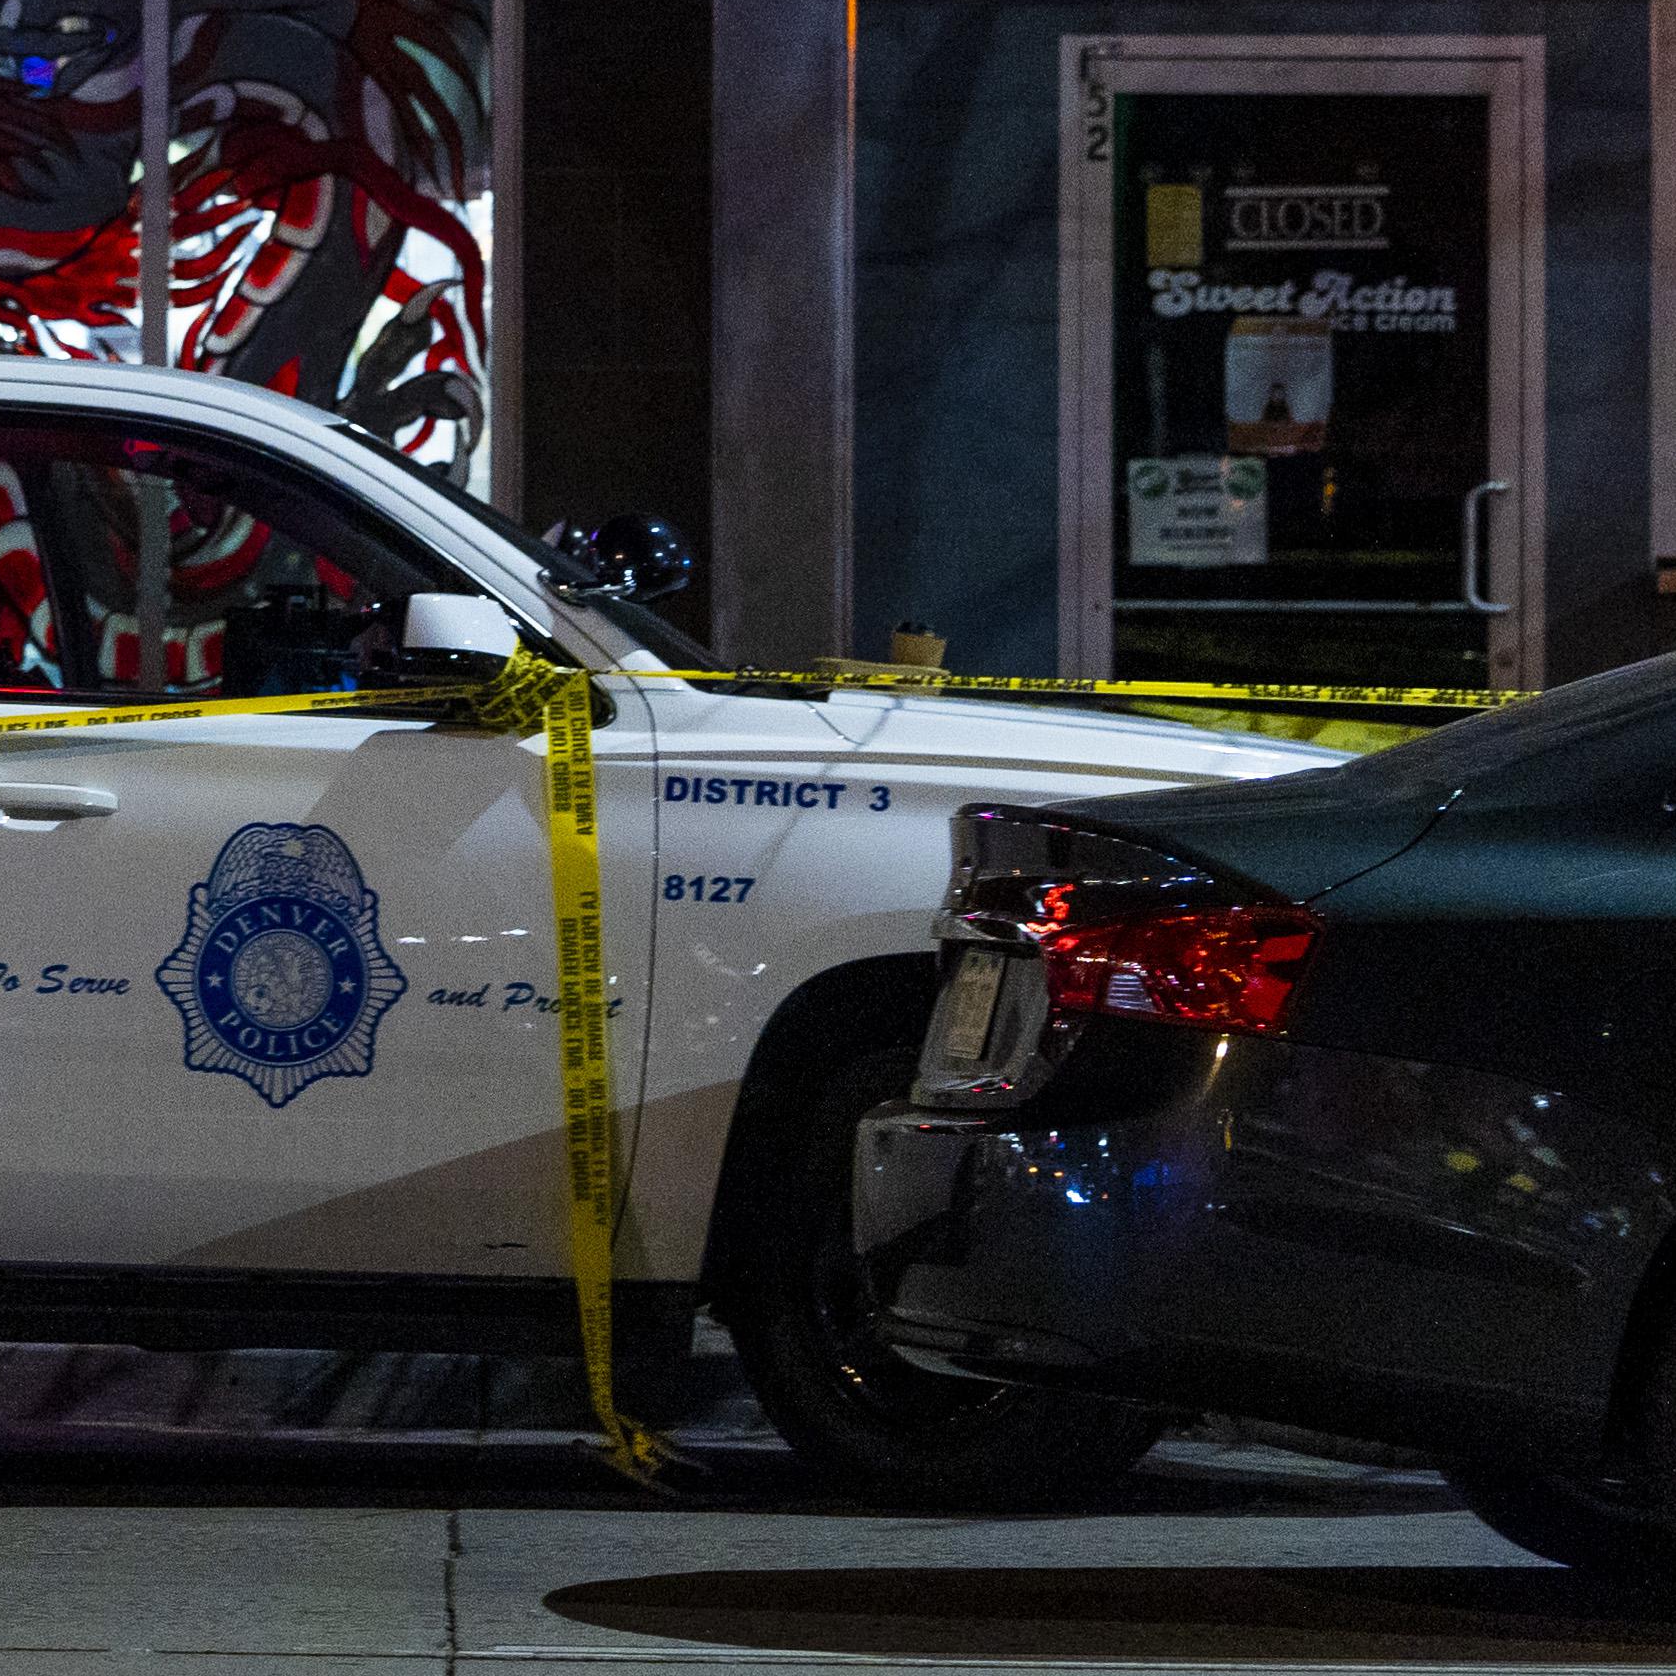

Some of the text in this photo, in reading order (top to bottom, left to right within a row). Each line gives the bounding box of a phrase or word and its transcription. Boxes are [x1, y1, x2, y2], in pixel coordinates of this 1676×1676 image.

[1232, 196, 1386, 238] CLOSED
[1147, 267, 1457, 319] Sweet Action
[663, 776, 891, 812] DISTRICT 3
[664, 874, 756, 904] 8127
[214, 901, 349, 959] DENVER
[34, 964, 132, 997] Serve
[426, 981, 623, 1019] and Prot
[216, 1012, 348, 1060] POLICE
